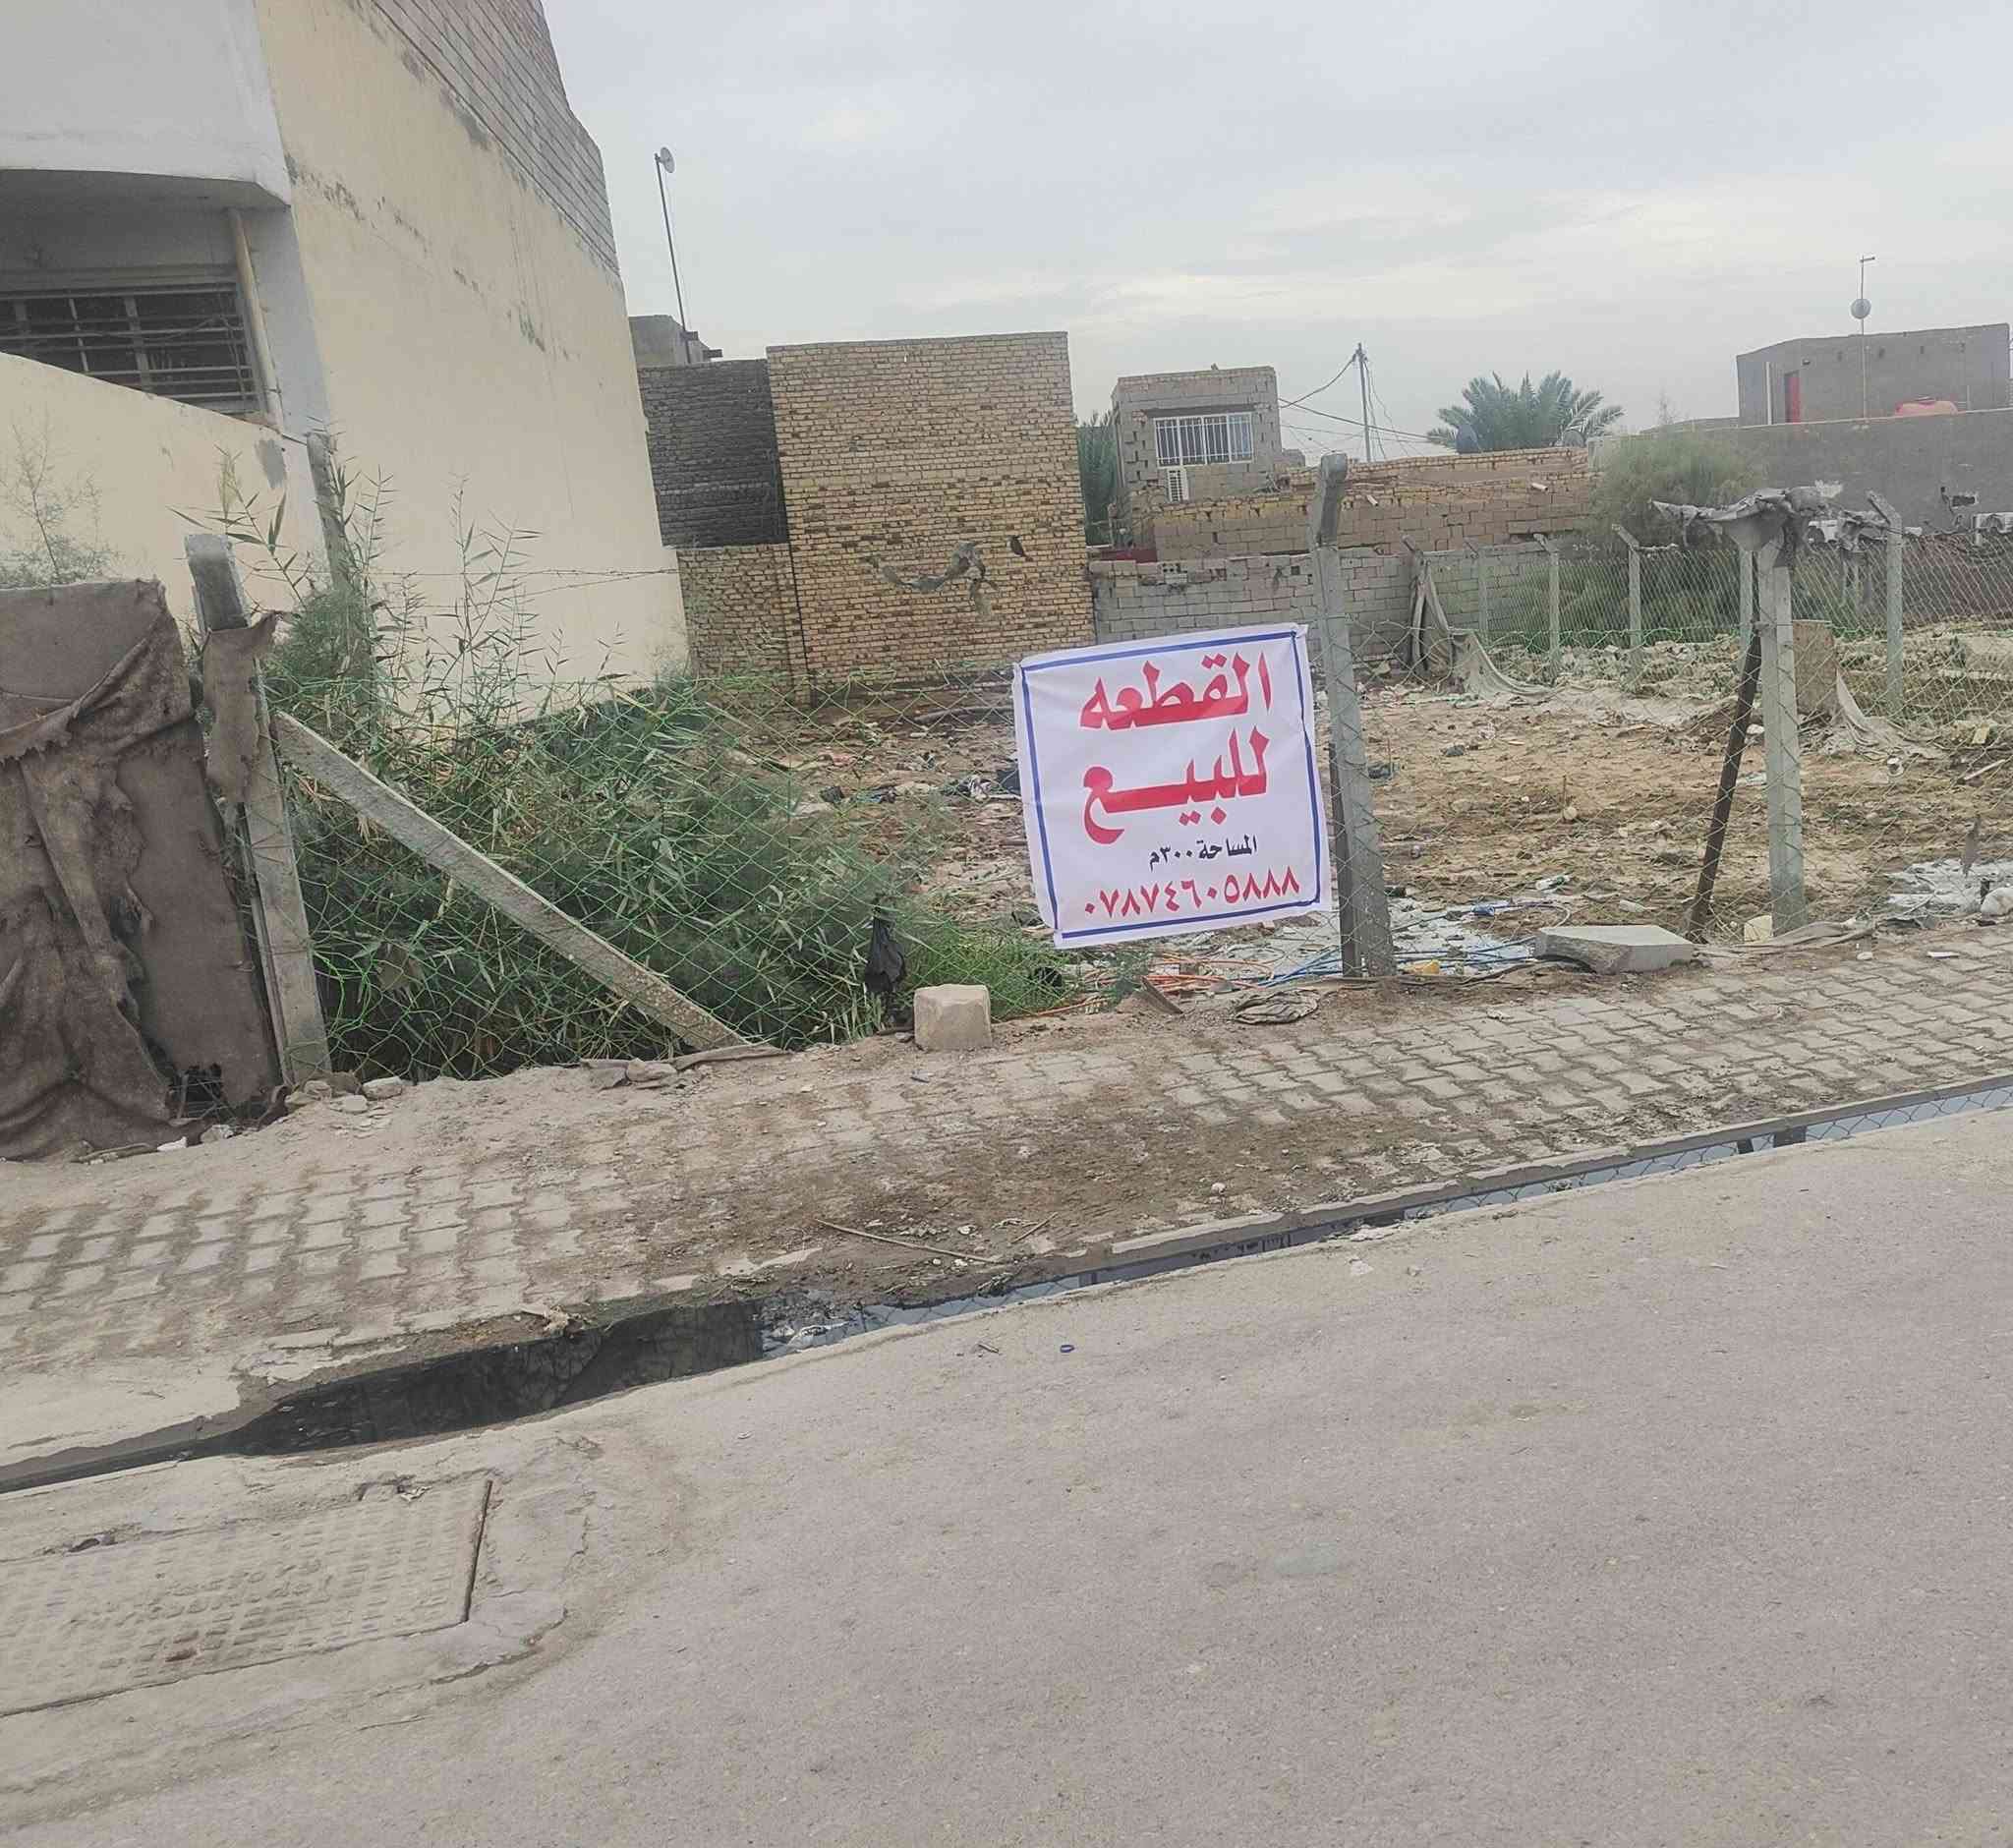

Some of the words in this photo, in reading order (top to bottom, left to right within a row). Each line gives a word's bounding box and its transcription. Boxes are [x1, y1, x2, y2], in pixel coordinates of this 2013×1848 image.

[1080, 652, 1271, 730] القطعه
[1083, 725, 1270, 844] للبيع
[1195, 834, 1258, 860] المساحة
[1084, 866, 1300, 919] ٠٧٨٧٤٦٠٥٨٨٨
